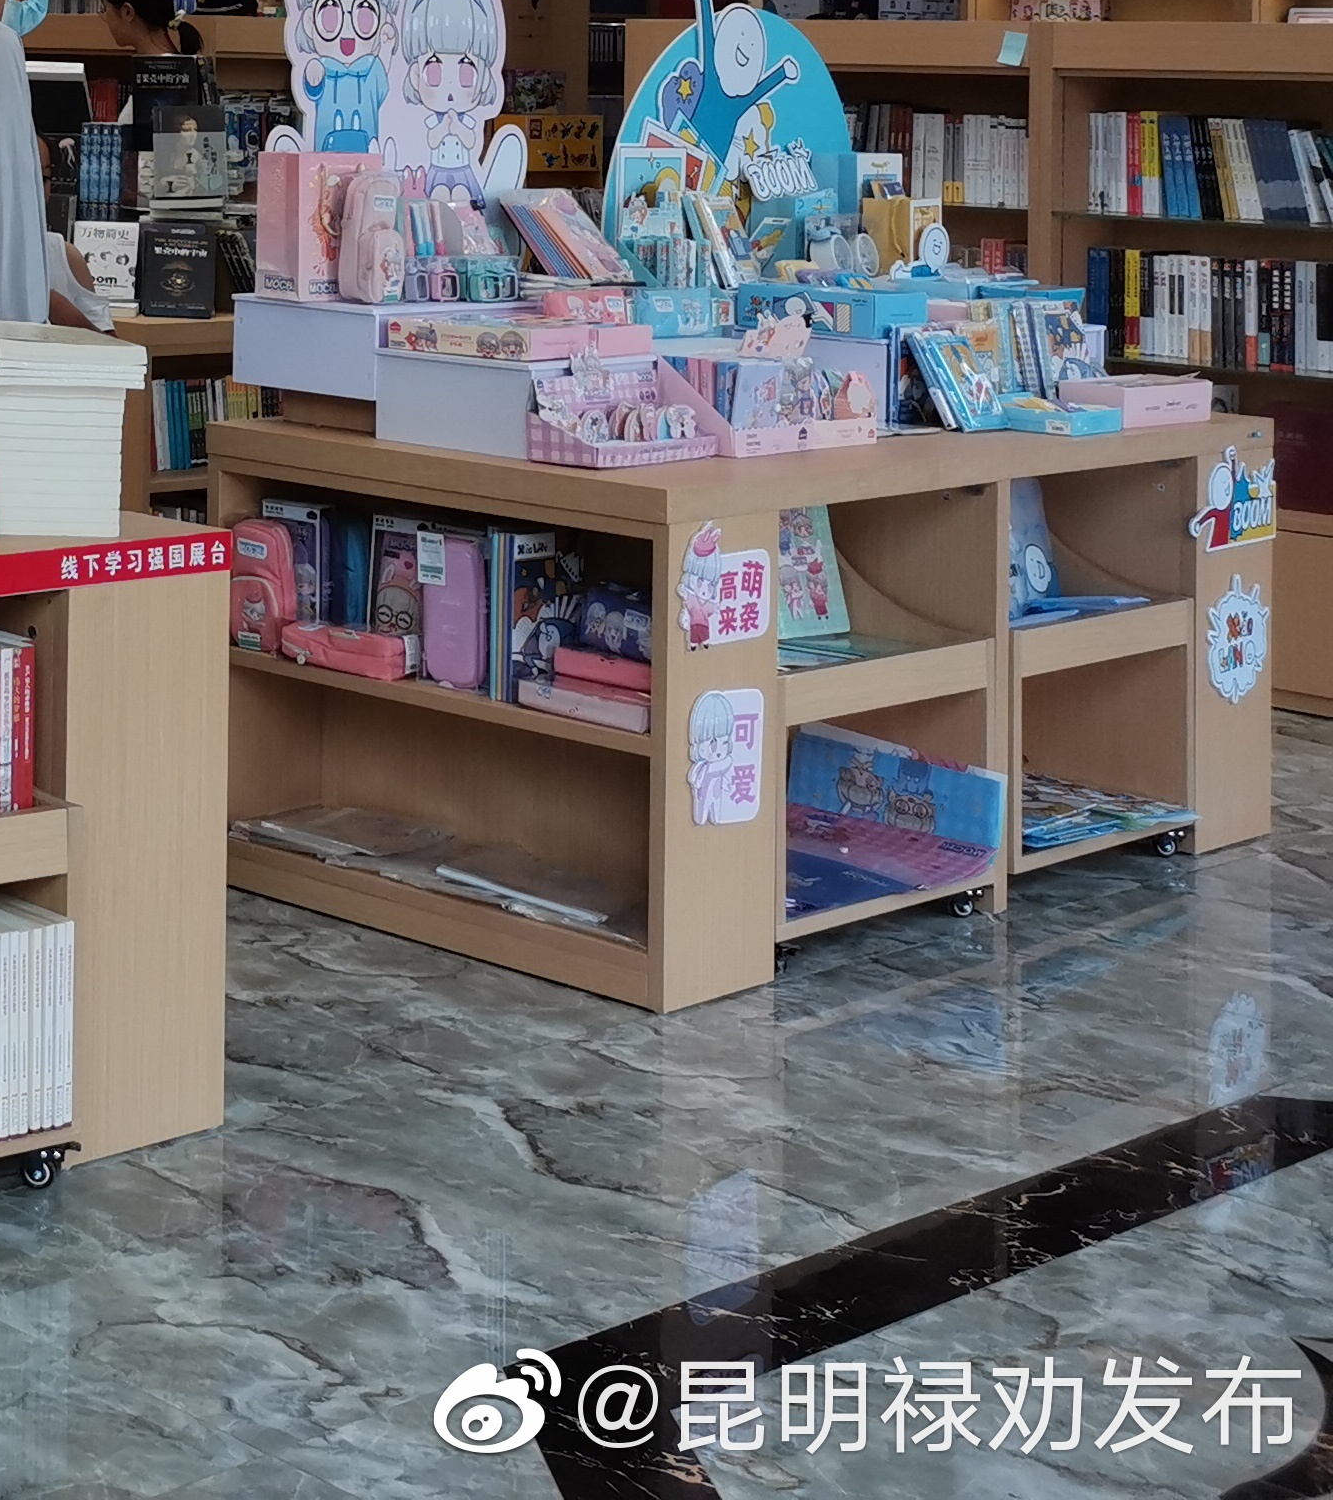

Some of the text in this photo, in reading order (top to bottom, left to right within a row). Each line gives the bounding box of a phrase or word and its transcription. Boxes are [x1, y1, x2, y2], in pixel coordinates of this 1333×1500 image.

[750, 153, 817, 197] BOOM
[81, 226, 130, 241] 万物简史
[1234, 498, 1271, 531] BOOM
[60, 543, 228, 581] 线下学习强国展台
[731, 713, 760, 804] 可爱
